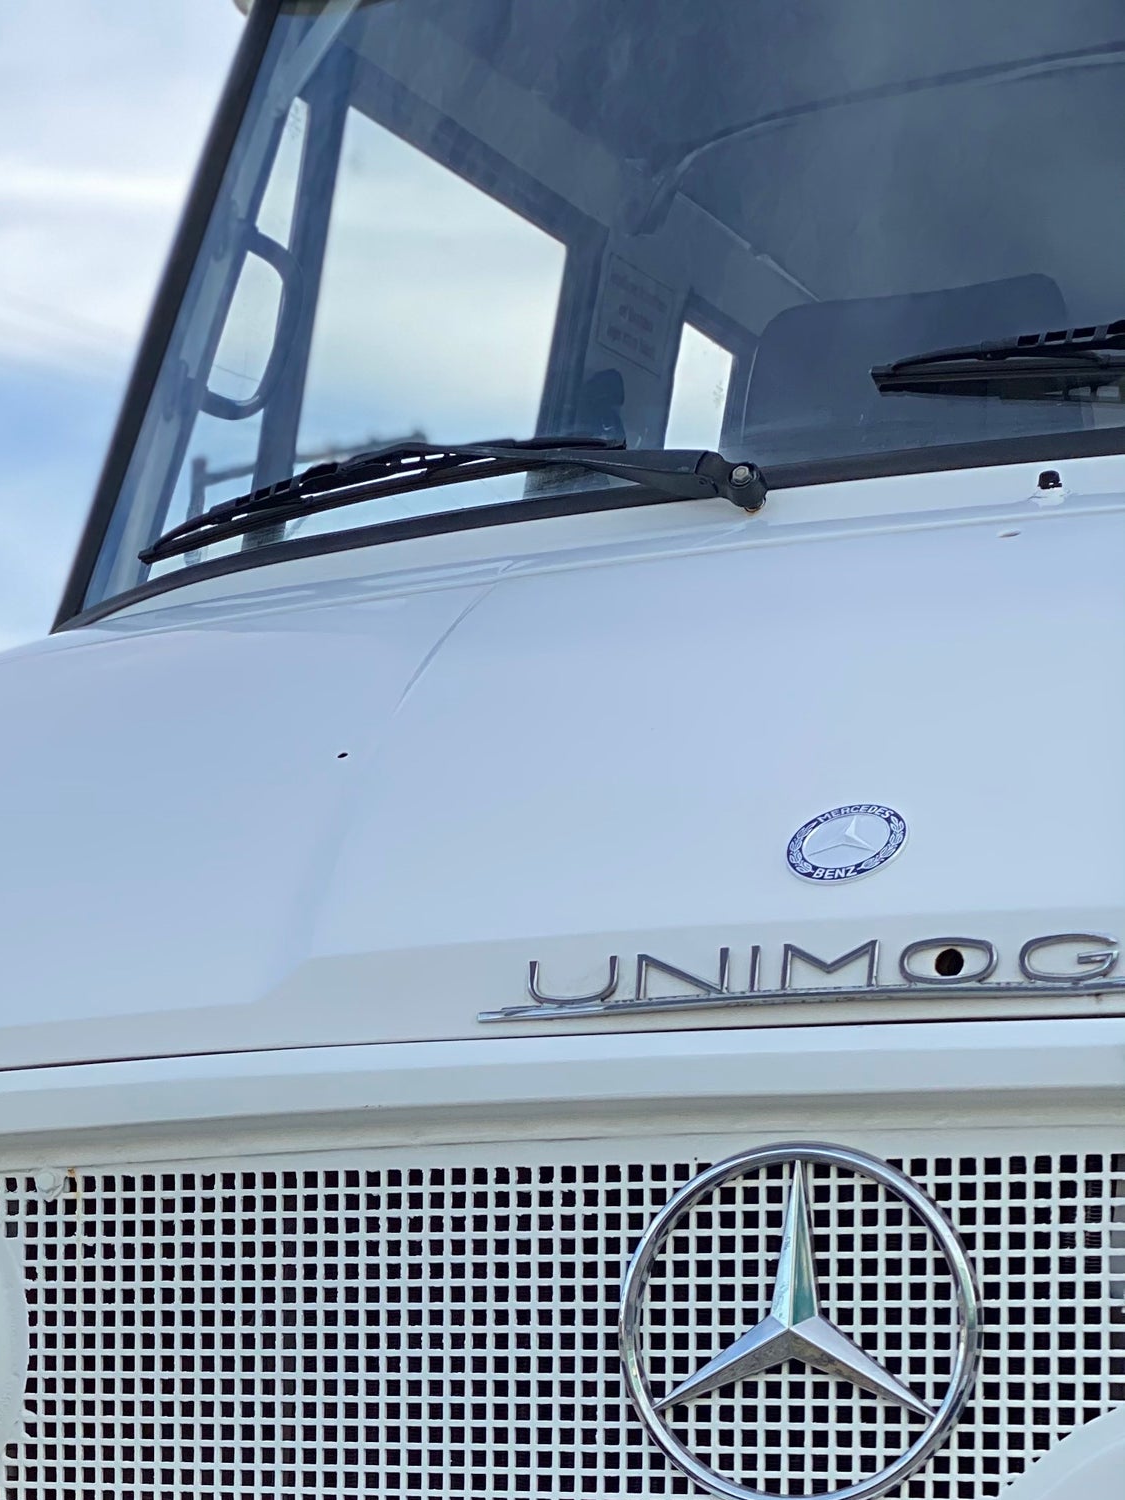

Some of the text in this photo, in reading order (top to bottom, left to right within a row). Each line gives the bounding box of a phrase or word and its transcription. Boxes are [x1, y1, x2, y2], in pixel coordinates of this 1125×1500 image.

[817, 805, 894, 823] MERCEDES
[812, 865, 858, 880] BENZ
[527, 933, 1119, 1004] UNIMOG
